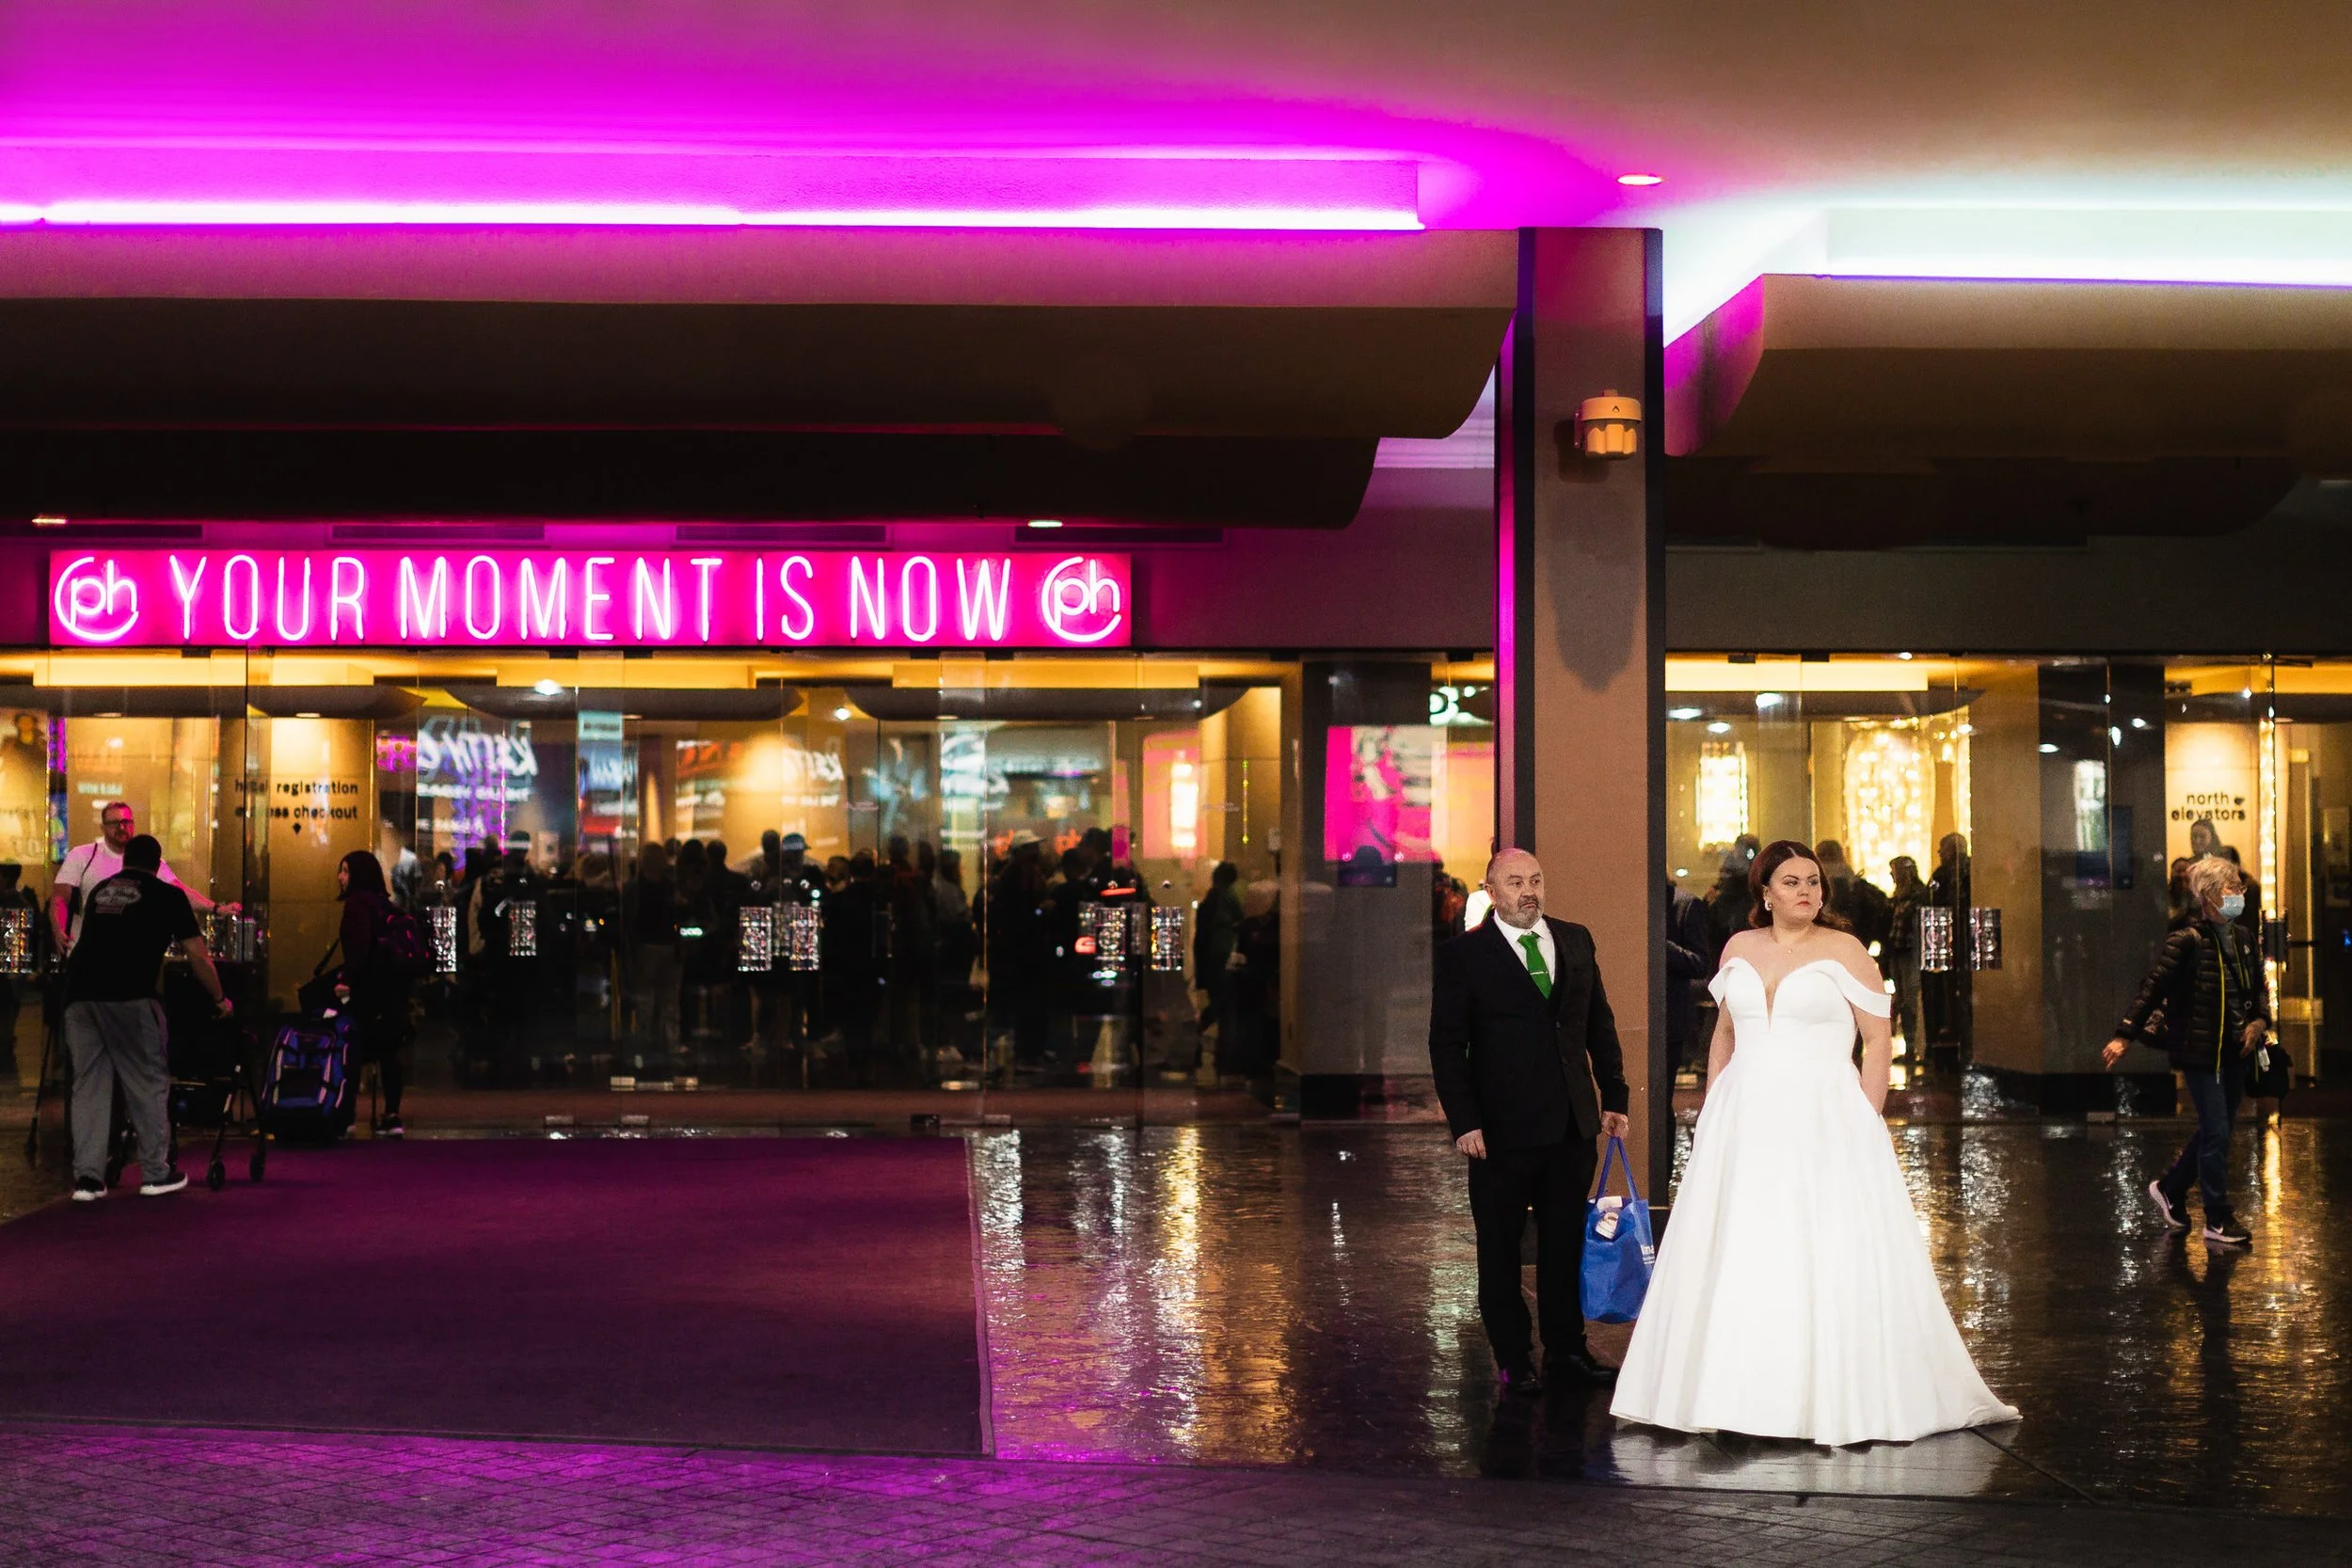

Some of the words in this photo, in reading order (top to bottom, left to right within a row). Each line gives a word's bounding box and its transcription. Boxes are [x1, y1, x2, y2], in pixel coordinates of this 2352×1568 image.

[170, 555, 365, 641] YOUR
[399, 556, 723, 641] MOMENT
[756, 556, 814, 641] IS
[850, 556, 1011, 642] NOW
[277, 781, 358, 796] registration
[2186, 791, 2230, 805] north
[2171, 806, 2246, 821] elevators
